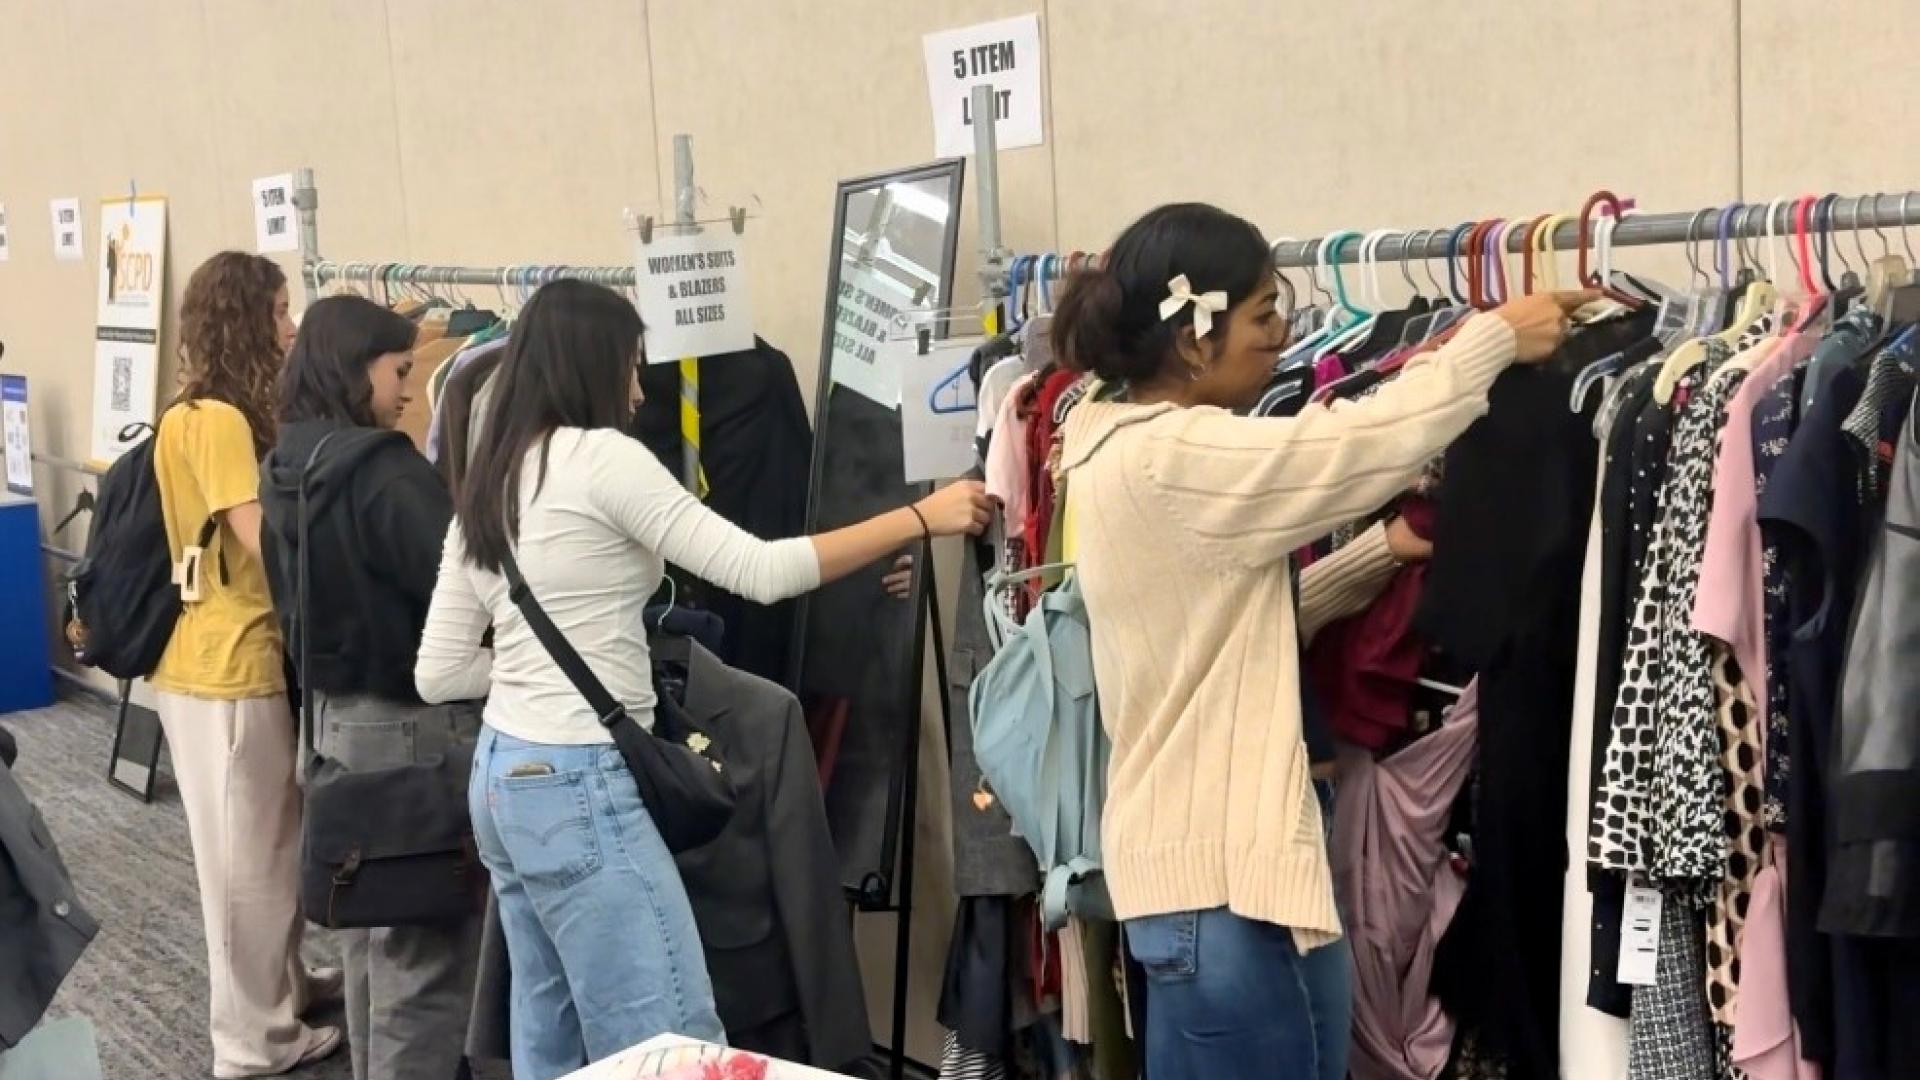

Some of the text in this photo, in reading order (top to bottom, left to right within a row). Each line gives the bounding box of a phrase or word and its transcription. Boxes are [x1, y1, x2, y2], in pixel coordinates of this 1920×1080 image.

[953, 40, 1015, 79] 5 ITEM
[963, 89, 1011, 125] LIT
[648, 250, 735, 275] WOMEN'S SUITS
[668, 277, 726, 299] & BLAZERS
[675, 304, 725, 326] ALL SIZES
